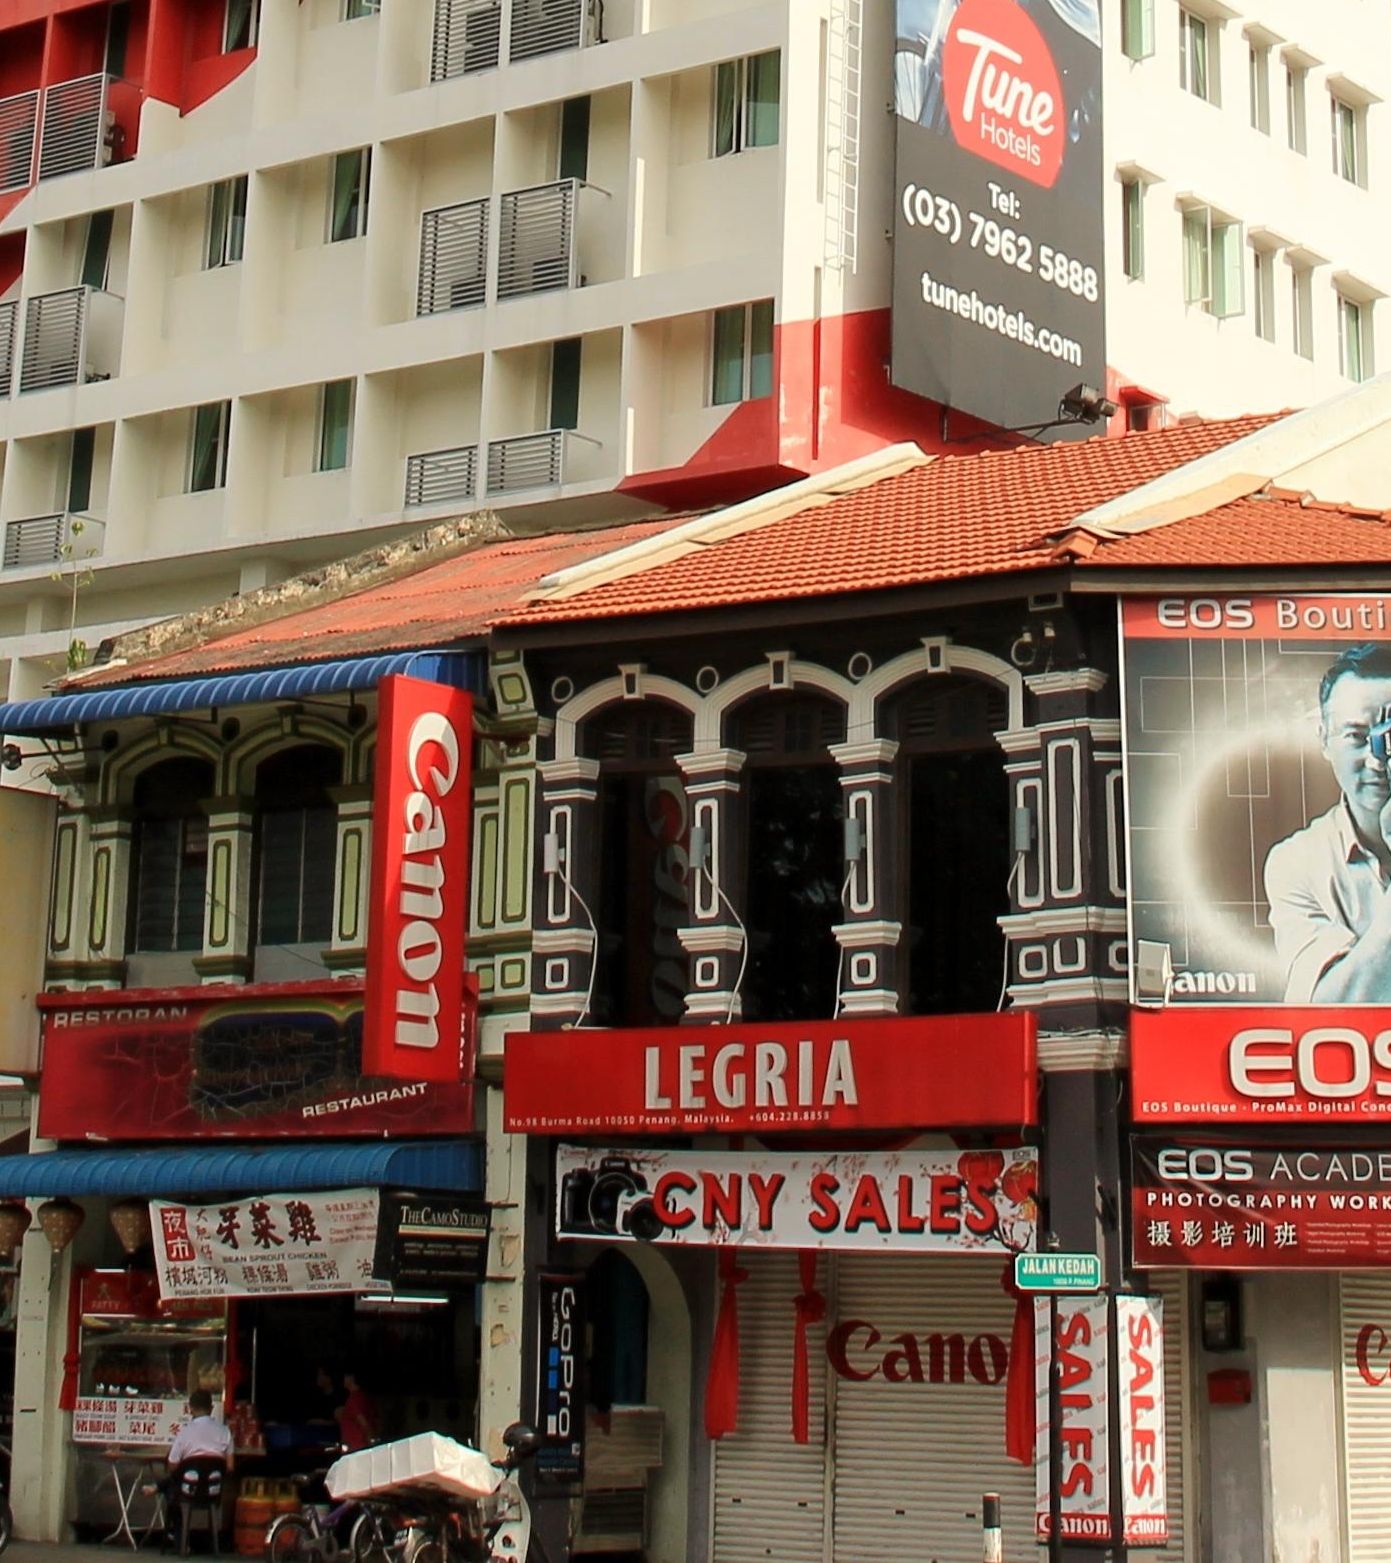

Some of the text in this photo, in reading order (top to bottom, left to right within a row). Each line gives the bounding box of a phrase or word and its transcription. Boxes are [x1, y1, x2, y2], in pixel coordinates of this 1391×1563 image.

[955, 27, 1055, 138] Tune
[979, 113, 1042, 169] Hotels
[988, 180, 1021, 221] Tel:
[903, 184, 1099, 303] (03) 7962 5888
[921, 271, 1083, 368] tunehotels.com
[1157, 598, 1255, 629] EOS
[394, 710, 460, 1050] Canon
[1171, 968, 1257, 995] anon
[54, 1006, 188, 1029] RESTORAN
[644, 1039, 859, 1111] LEGRIA
[302, 1082, 429, 1118] RESTAURANT
[1142, 1101, 1168, 1113] EOS
[1173, 1101, 1237, 1114] Boutique
[1251, 1101, 1303, 1113] ProMax
[1308, 1101, 1357, 1115] Digital
[541, 1117, 573, 1127] Burma
[576, 1116, 602, 1126] Road
[605, 1115, 636, 1126] 10050
[1158, 1148, 1254, 1182] EOS
[652, 1170, 1000, 1234] CNY SALES
[1146, 1192, 1317, 1210] PHOTOGRAPHY
[163, 1211, 191, 1259] 夜市
[1147, 1219, 1299, 1249] 摄影培训班
[249, 1252, 286, 1263] SPROUT
[287, 1251, 328, 1261] CHICKEN
[1022, 1258, 1095, 1275] JALAN KEDAH
[826, 1318, 1010, 1386] Cano
[1128, 1313, 1155, 1497] SALES
